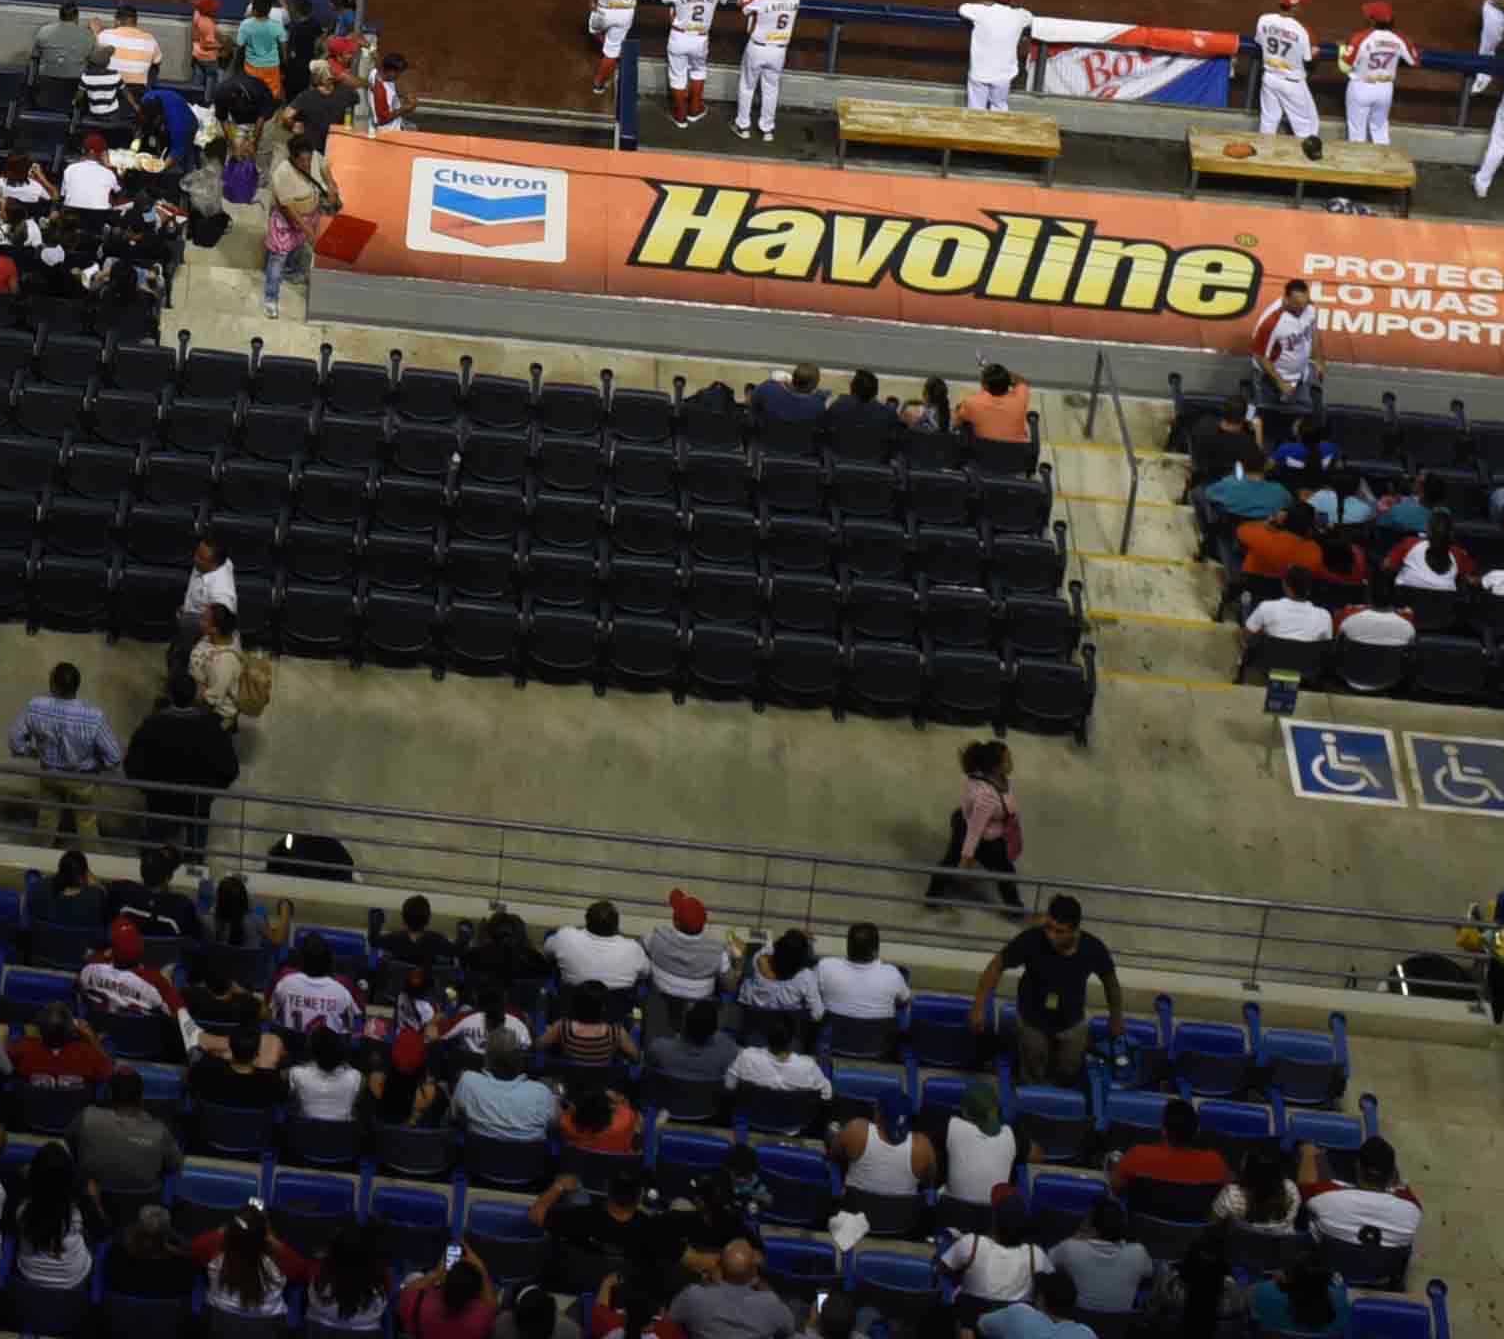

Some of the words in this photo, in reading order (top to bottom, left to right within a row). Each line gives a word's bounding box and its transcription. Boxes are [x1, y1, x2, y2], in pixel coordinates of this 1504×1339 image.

[692, 5, 705, 22] 2
[775, 13, 789, 30] 6
[1266, 36, 1292, 57] 97
[1367, 52, 1395, 70] 57
[433, 167, 548, 191] Chevron
[1308, 280, 1375, 306] LO
[1389, 286, 1500, 318] MAS
